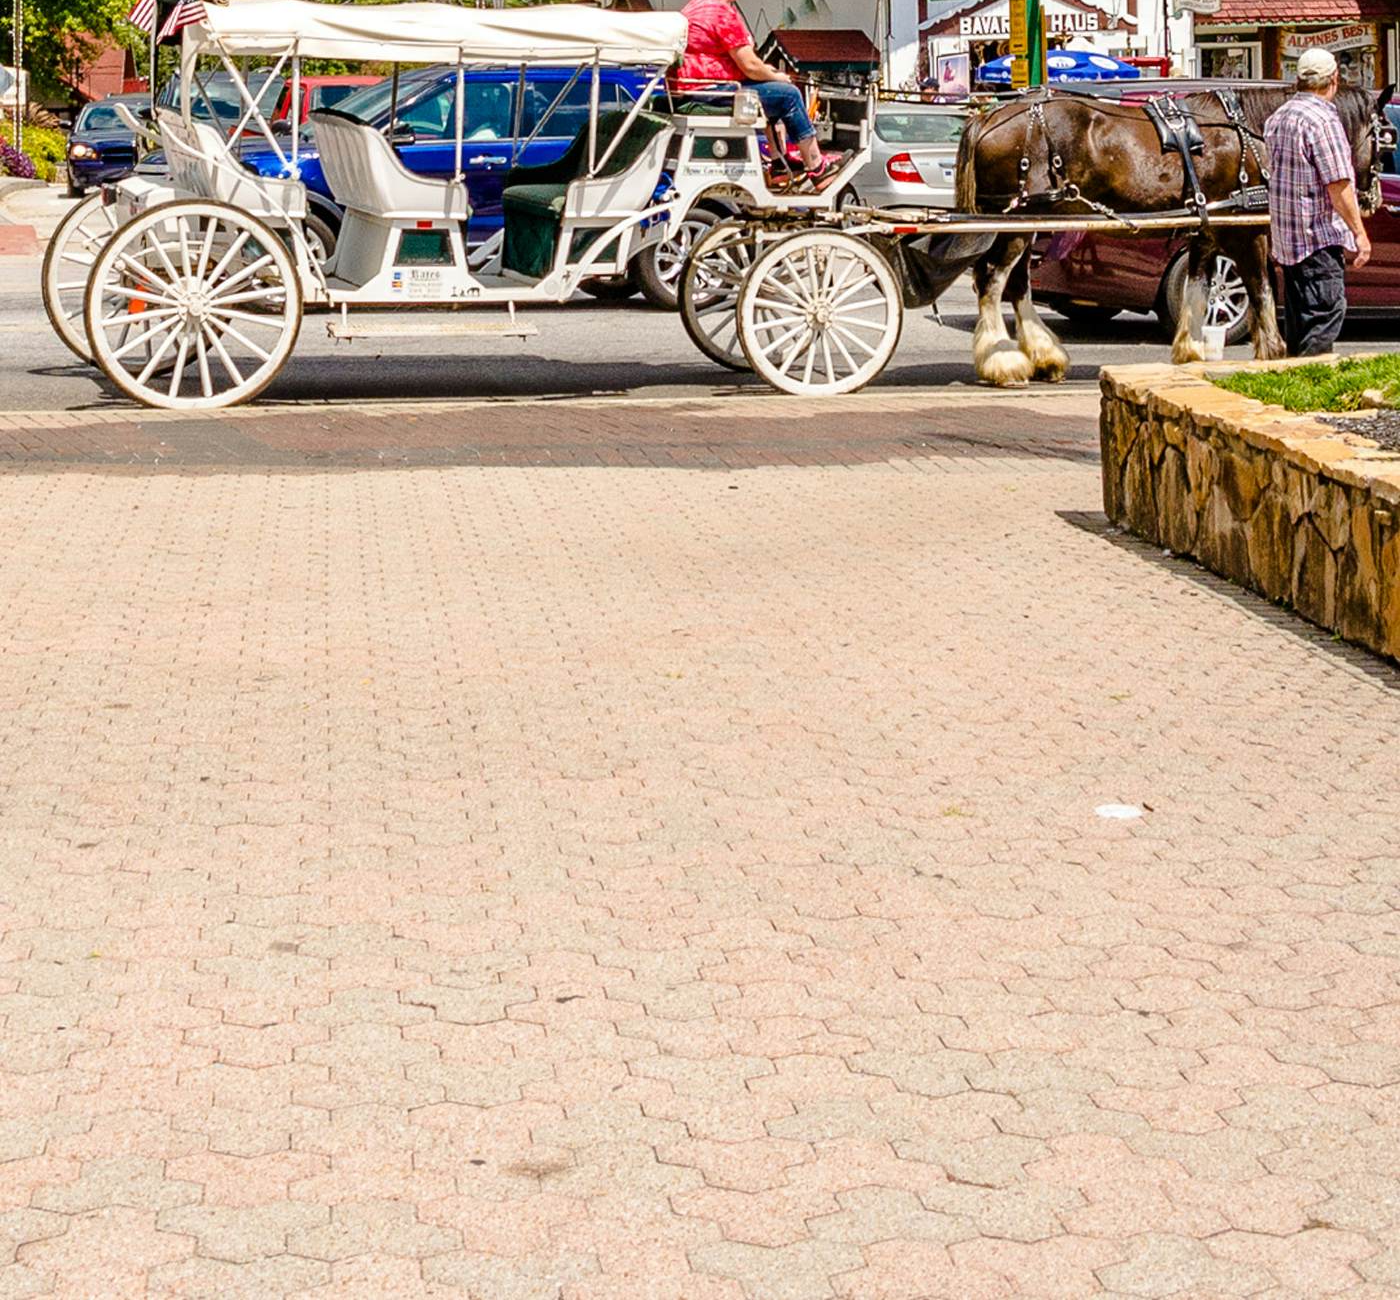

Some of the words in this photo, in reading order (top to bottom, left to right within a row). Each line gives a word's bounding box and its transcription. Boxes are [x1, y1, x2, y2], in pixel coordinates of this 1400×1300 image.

[960, 16, 1010, 35] BAVAR
[1051, 13, 1098, 32] HAUS
[1287, 30, 1338, 48] ALPINES
[1342, 23, 1371, 39] BEST
